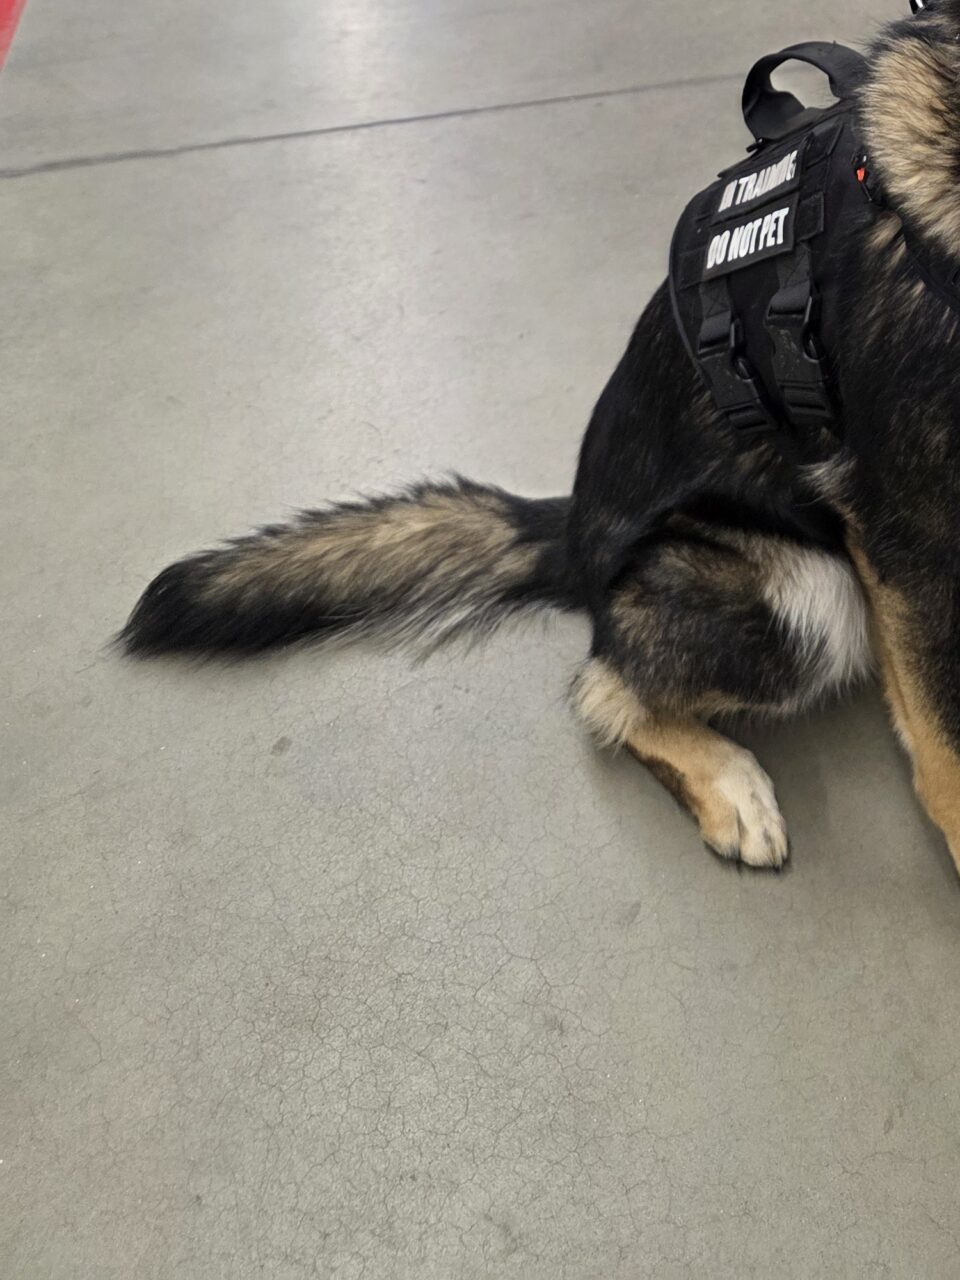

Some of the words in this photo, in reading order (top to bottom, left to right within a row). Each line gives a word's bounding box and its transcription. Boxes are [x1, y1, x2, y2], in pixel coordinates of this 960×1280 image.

[706, 229, 731, 270] DO
[727, 217, 763, 262] NOT
[758, 206, 790, 251] PET
